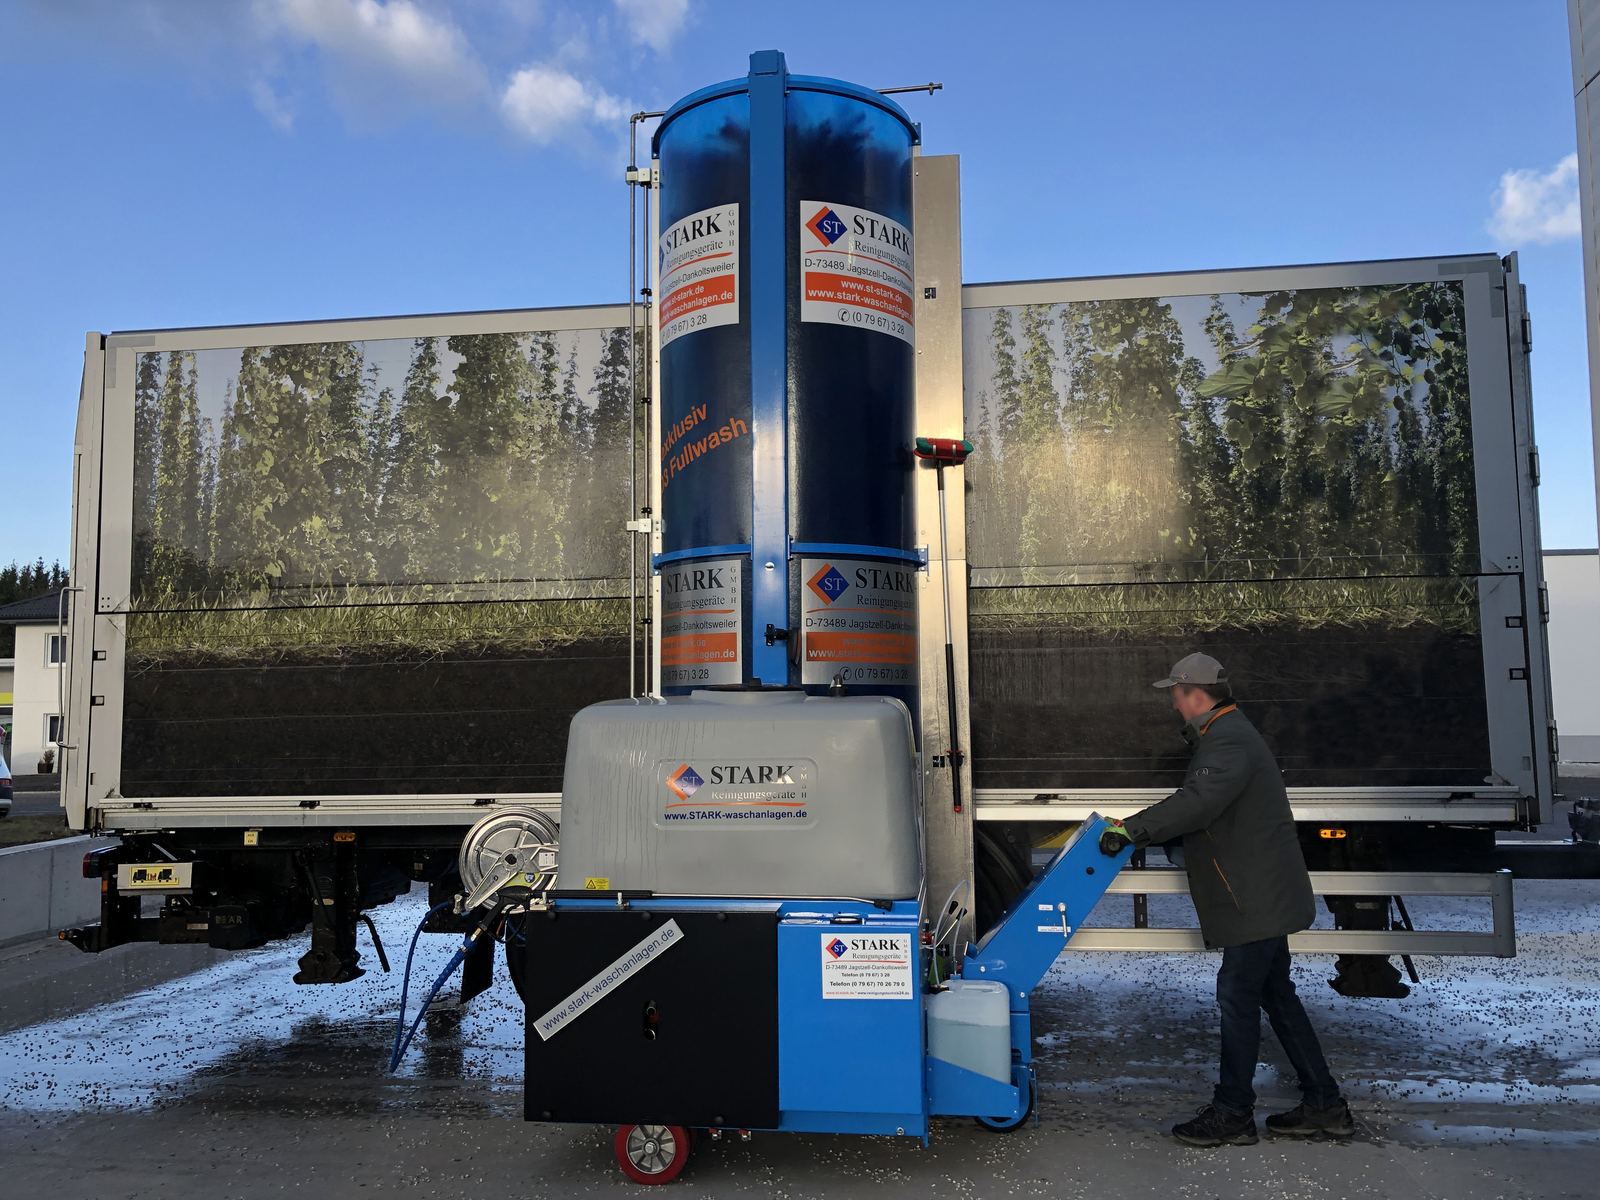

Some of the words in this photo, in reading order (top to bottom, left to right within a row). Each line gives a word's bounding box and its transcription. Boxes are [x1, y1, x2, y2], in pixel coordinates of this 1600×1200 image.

[666, 213, 722, 255] STARK
[823, 219, 842, 235] ST
[853, 214, 911, 256] STARK
[805, 258, 845, 271] D-73489
[697, 313, 708, 326] 28
[852, 311, 862, 324] (0
[865, 313, 876, 326] 79
[877, 316, 890, 331] 67)
[669, 417, 748, 479] Fullwash
[666, 567, 725, 595] STARK
[824, 577, 843, 591] ST
[855, 567, 914, 593] STARK
[806, 617, 847, 628] D-73489
[691, 668, 697, 680] 3
[698, 668, 709, 680] 28
[867, 668, 878, 679] 79
[681, 775, 699, 789] ST
[710, 765, 795, 785] STARK
[664, 810, 807, 821] www.STARK-waschanlagen.de
[834, 944, 844, 953] ST
[851, 939, 900, 951] STARK
[543, 928, 675, 1031] www.stark-waschanlagen.de
